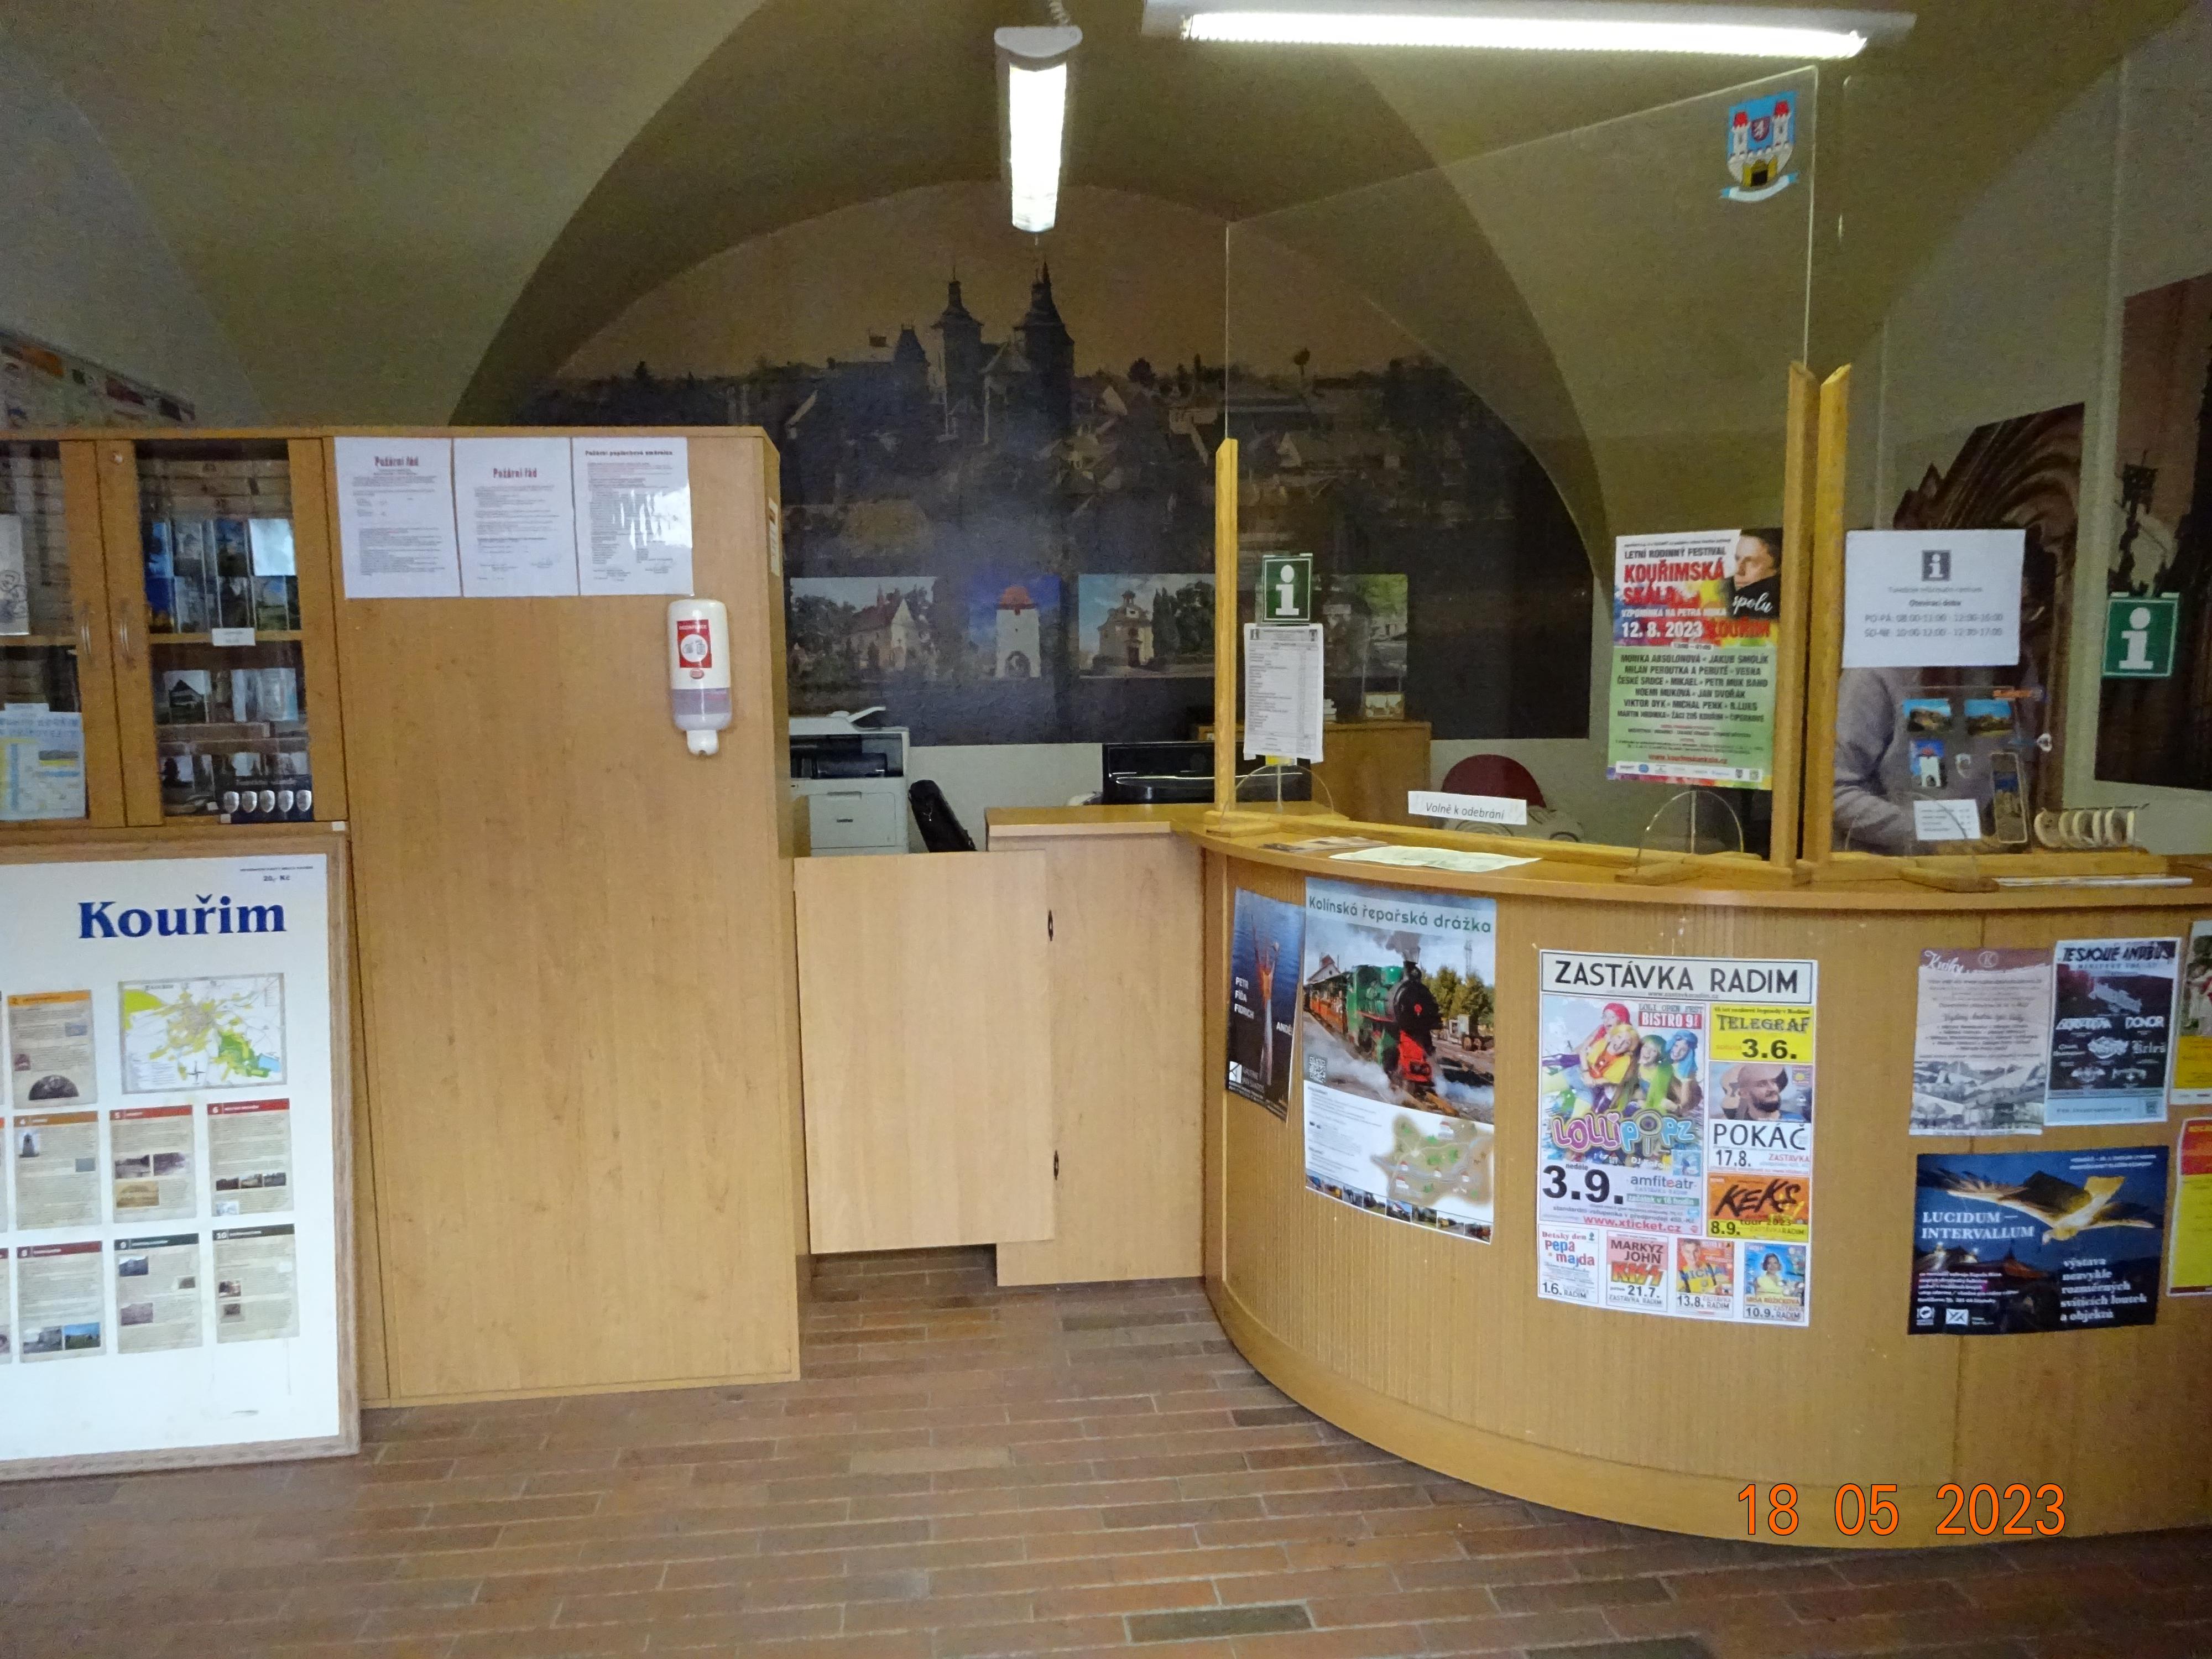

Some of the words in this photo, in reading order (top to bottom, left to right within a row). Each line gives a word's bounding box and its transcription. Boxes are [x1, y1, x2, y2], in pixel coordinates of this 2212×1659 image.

[493, 468, 522, 478] Požární
[525, 468, 537, 478] řád
[1624, 548, 1647, 559] LETNÍ
[1648, 547, 1684, 559] RODINNÝ
[1687, 546, 1726, 557] FESTIVAL
[1624, 557, 1725, 583] KOUŘIMSKÁ
[1732, 592, 1773, 615] spolu
[1622, 622, 1642, 638] 12.
[1646, 622, 1661, 638] 8.
[1666, 620, 1703, 638] 2023
[1651, 654, 1700, 663] ABSOLONOVÁ
[1709, 655, 1735, 664] JAKUB
[1738, 654, 1768, 664] SMOLÍK
[1618, 675, 1639, 685] ČESKÉ
[1641, 677, 1663, 685] SRDCE
[1671, 677, 1698, 686] MIKAEL
[1726, 679, 1744, 687] MUK
[1746, 679, 1768, 687] BAND
[1660, 687, 1691, 697] MUKOVÁ
[1698, 690, 1712, 698] JAN
[1715, 688, 1745, 698] DVOŘÁK
[1624, 699, 1648, 707] VIKTOR
[1651, 700, 1666, 708] DYK
[1672, 701, 1699, 709] MICHAL
[1426, 802, 1452, 814] Volně
[1454, 805, 1459, 815] k
[1462, 807, 1505, 820] odebrání
[78, 893, 288, 939] Kouřim
[1309, 896, 1358, 916] Kolínská
[1362, 904, 1428, 927] řepařská
[1433, 914, 1491, 933] drážka
[1235, 977, 1249, 990] PETR
[1555, 960, 1694, 991] ZASTÁVKA
[1710, 968, 1798, 994] RADIM
[1234, 1003, 1254, 1019] FIDRICH
[1641, 1013, 1683, 1027] BISTRO
[1717, 1014, 1811, 1034] TELEGRAF
[2125, 1015, 2165, 1029] DONOR
[1742, 1039, 1797, 1059] 3.6.
[1714, 1123, 1806, 1150] POKÁČ
[1715, 1149, 1751, 1167] 17.8.
[1542, 1165, 1624, 1204] 3.9.
[1630, 1175, 1694, 1190] amfiteatr
[1715, 1178, 1802, 1217] KEKS
[1583, 1215, 1682, 1232] www.xticket.cz
[1923, 1212, 2001, 1223] LUCIDUM
[1710, 1220, 1740, 1235] 8.9.
[1921, 1225, 2035, 1240] INTERVALLUM
[1572, 1232, 1587, 1240] den
[1610, 1240, 1663, 1254] MARKÝZ
[1624, 1251, 1661, 1264] JOHN
[2063, 1258, 2106, 1269] výstava
[1542, 1282, 1563, 1295] 1.6.
[1563, 1289, 1587, 1299] RADIM
[1627, 1285, 1661, 1298] 21.7.
[1642, 1296, 1663, 1305] RADIM
[1677, 1295, 1704, 1308] 13.8.
[1707, 1301, 1730, 1310] RADIM
[2110, 1293, 2147, 1304] loutek
[1746, 1307, 1775, 1318] 10.9.
[1776, 1311, 1801, 1319] RADIM
